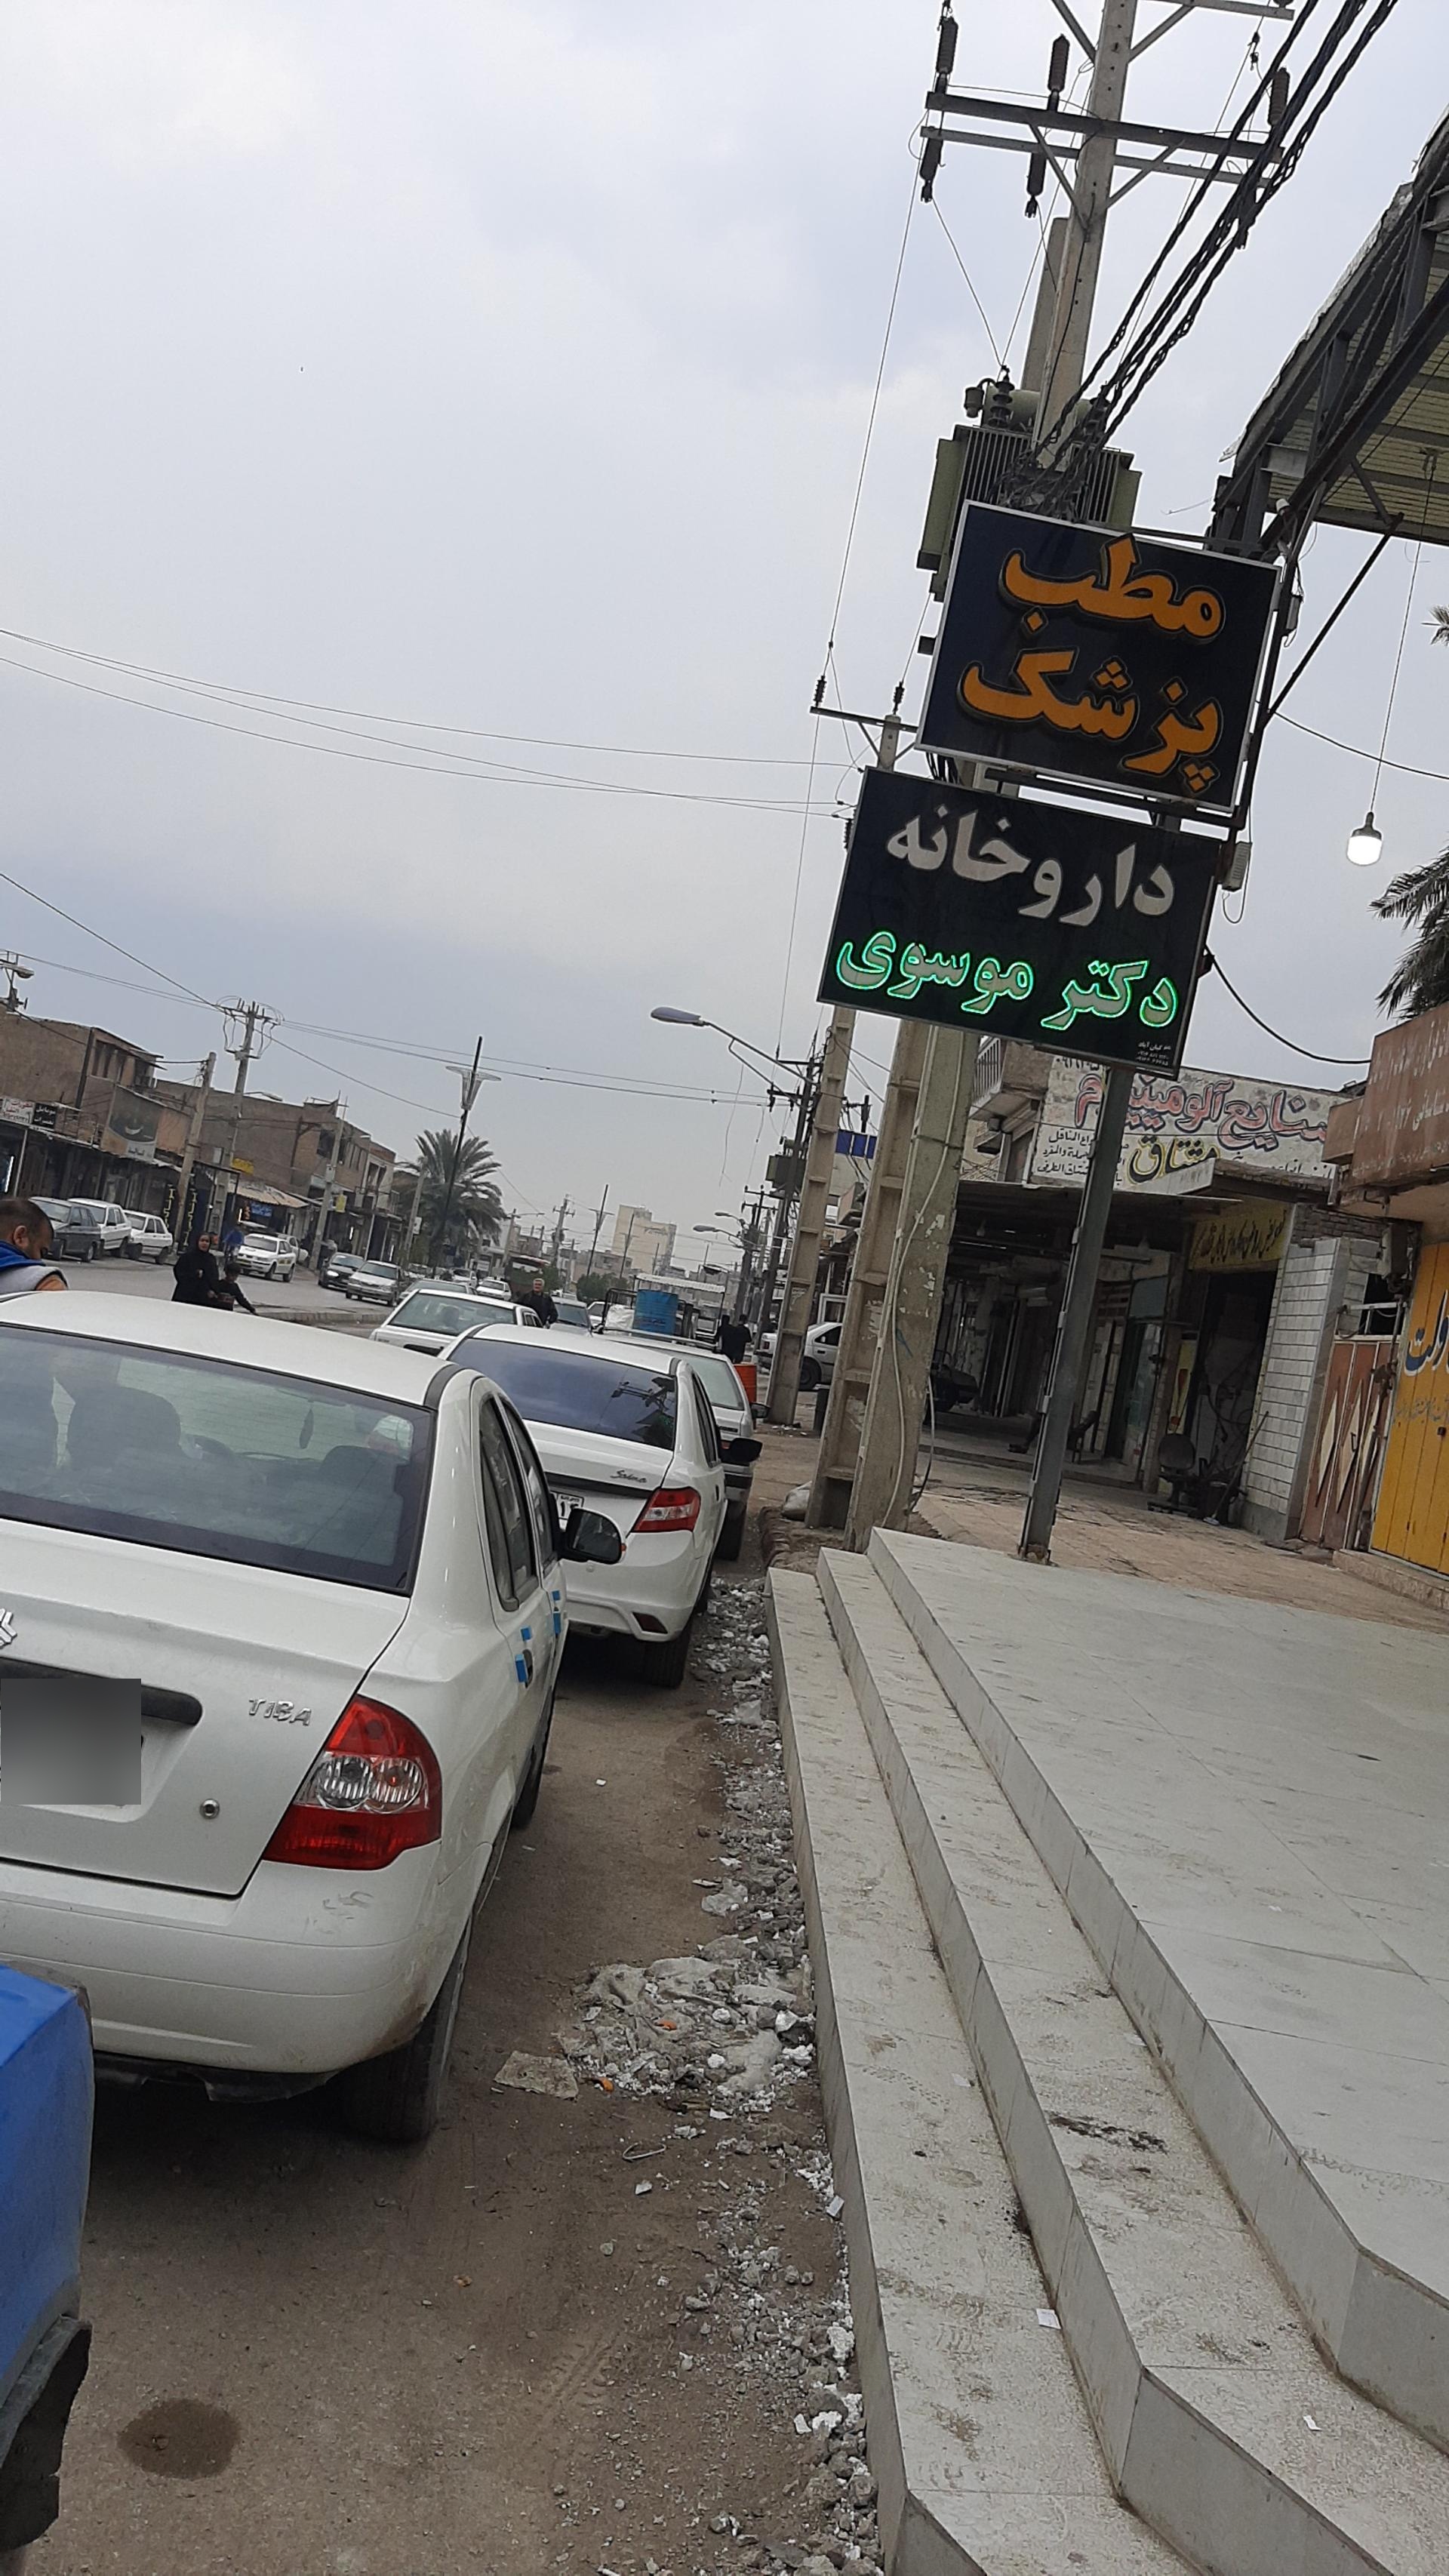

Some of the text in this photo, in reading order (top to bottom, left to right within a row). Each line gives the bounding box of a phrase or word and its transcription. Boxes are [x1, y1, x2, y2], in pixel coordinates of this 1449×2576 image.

[1001, 533, 1224, 642] مطب
[959, 648, 1223, 792] پزشک
[886, 804, 1174, 926] داروخانه
[835, 930, 1179, 1030] دکتر موسوی
[1075, 1073, 1235, 1133] آلومینیم
[1217, 1090, 1327, 1153] نایع
[1065, 1160, 1089, 1175] شتاق
[248, 1698, 312, 1726] TIBA
